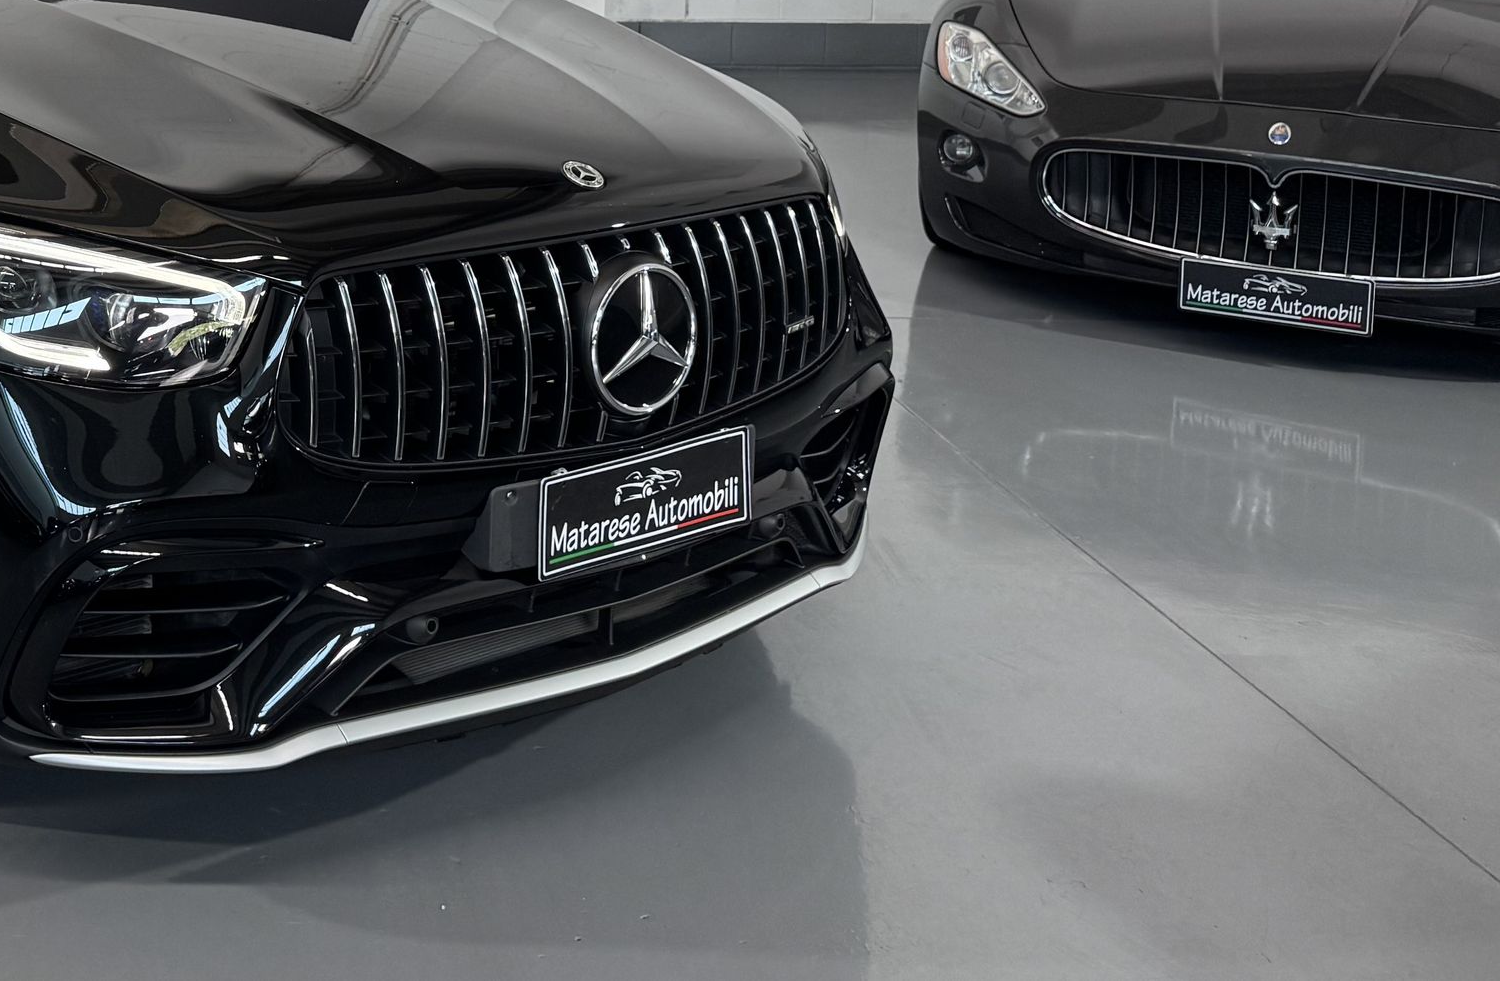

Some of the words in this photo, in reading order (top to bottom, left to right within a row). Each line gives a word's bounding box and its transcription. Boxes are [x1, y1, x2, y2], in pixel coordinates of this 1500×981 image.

[1186, 282, 1267, 311] Matarese
[1270, 295, 1363, 324] Automobili
[550, 512, 640, 556] Matarese
[645, 476, 738, 530] Automobili
